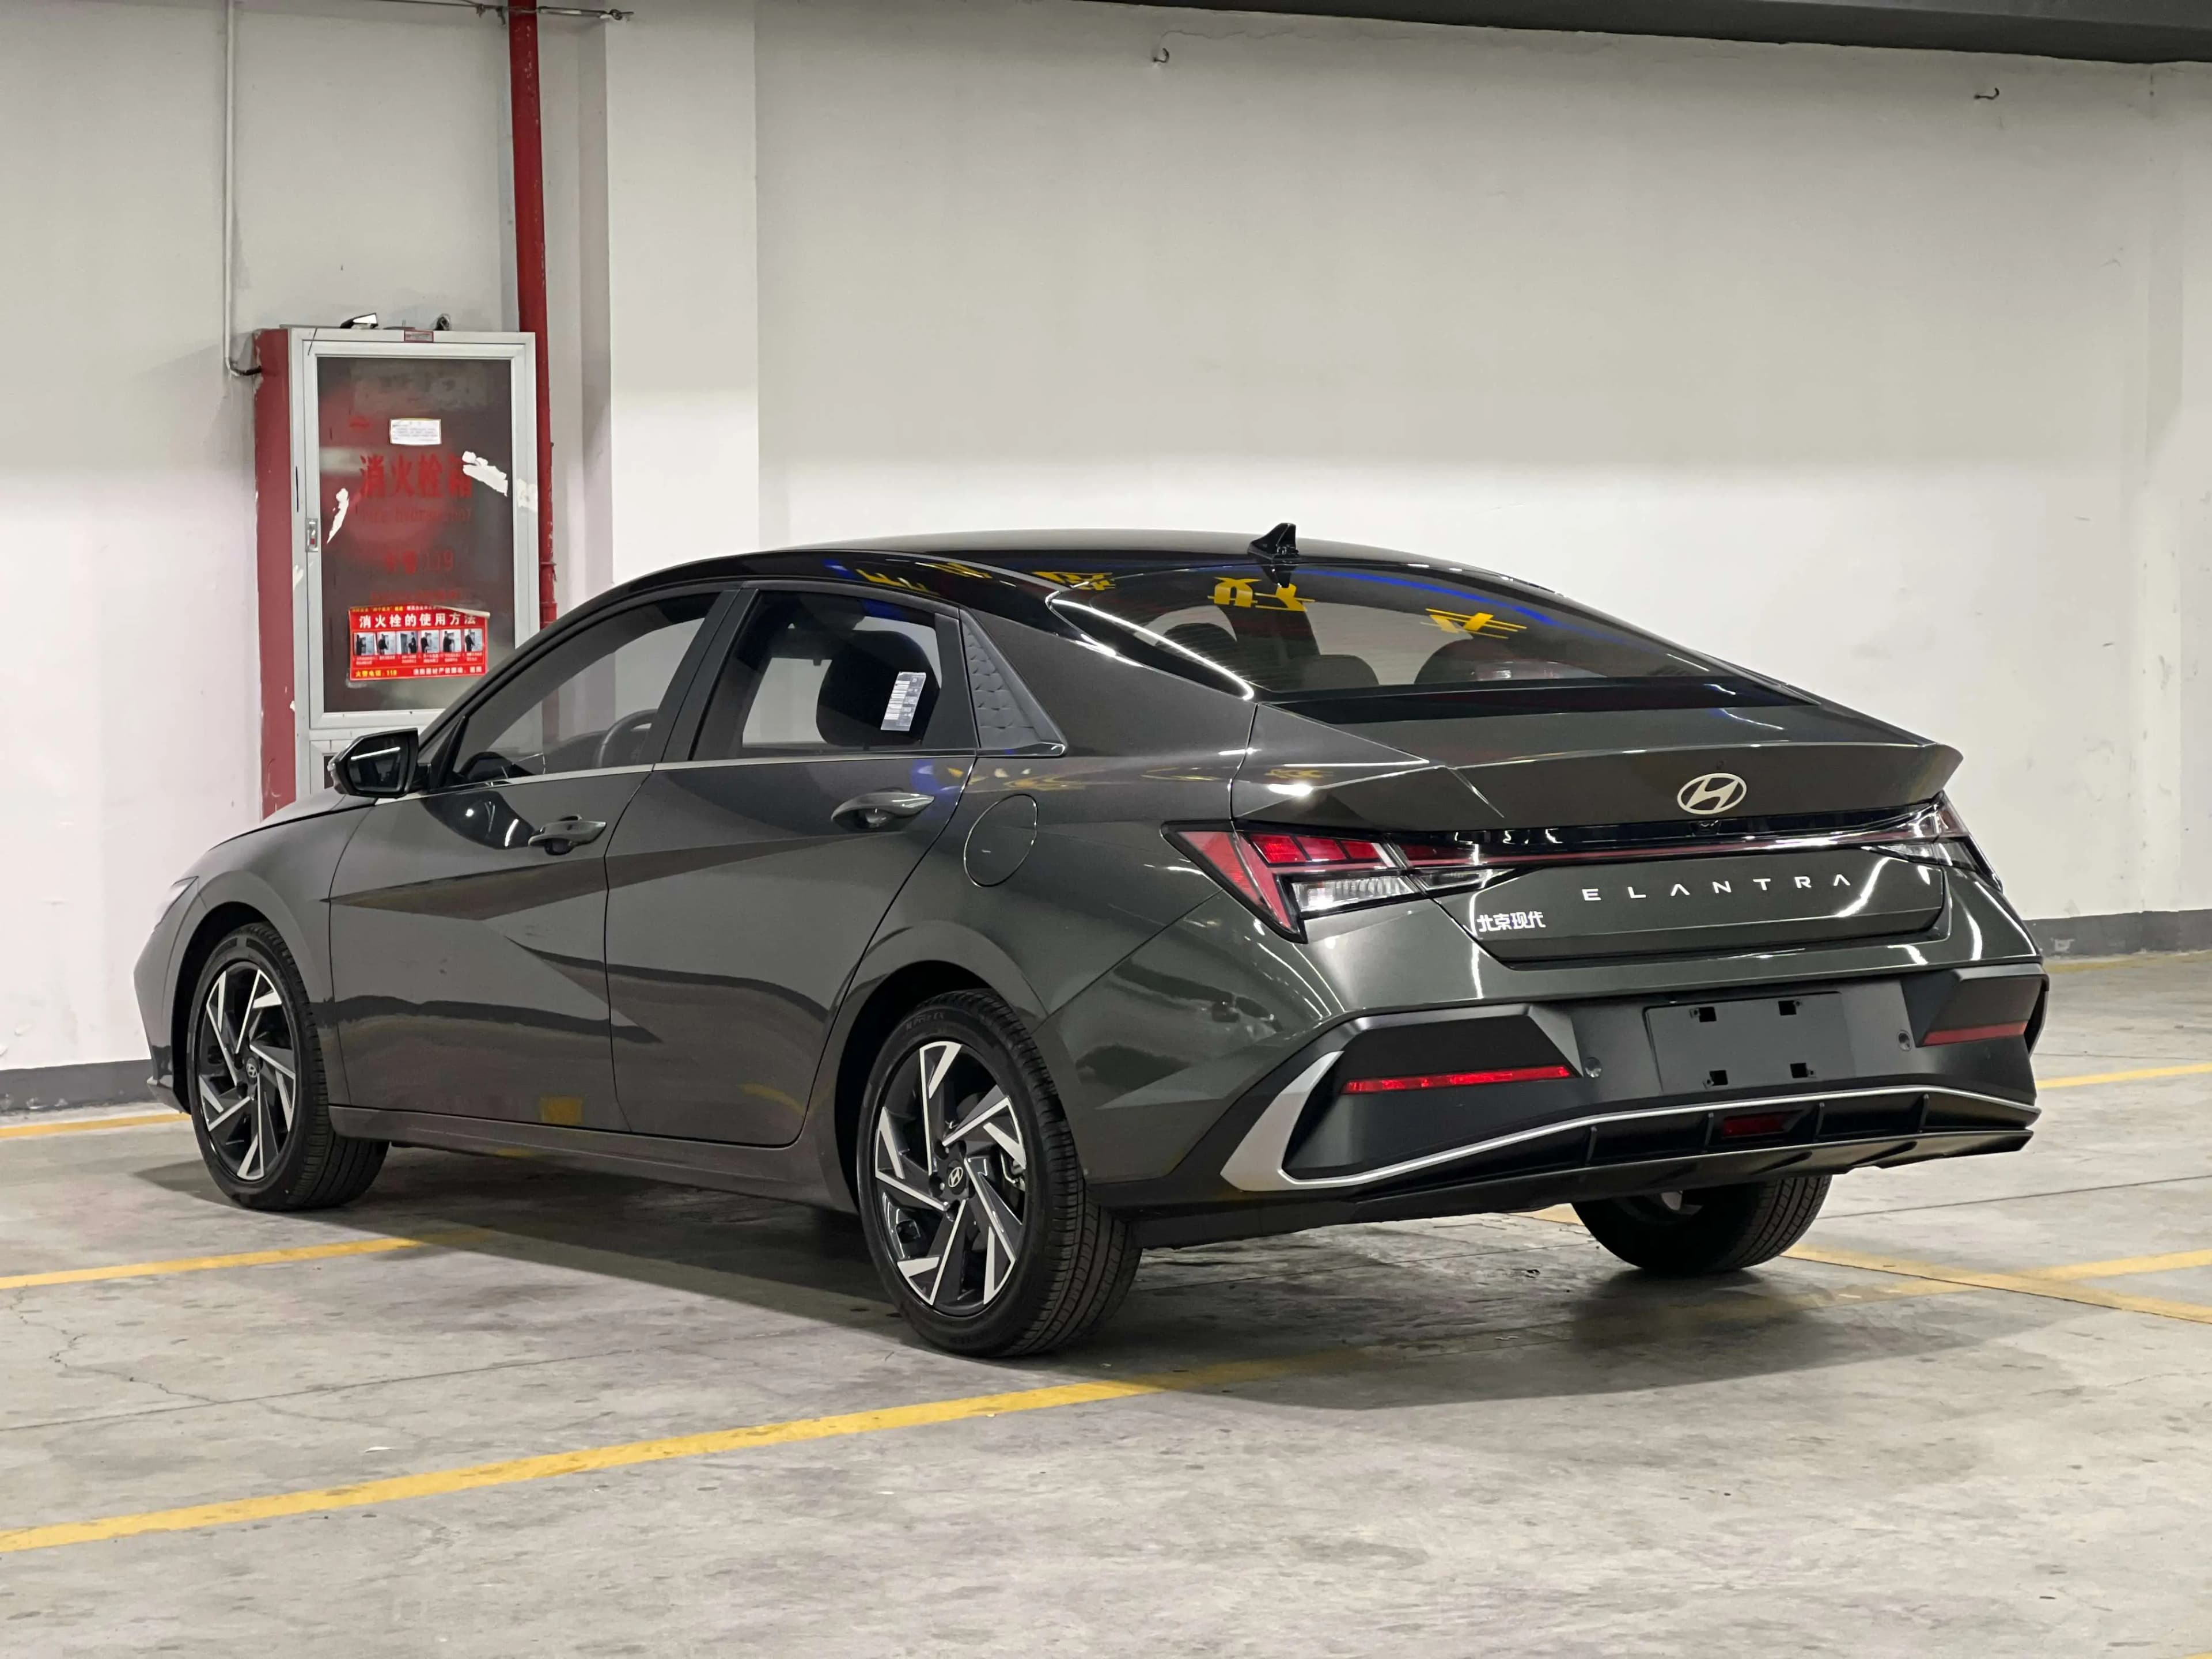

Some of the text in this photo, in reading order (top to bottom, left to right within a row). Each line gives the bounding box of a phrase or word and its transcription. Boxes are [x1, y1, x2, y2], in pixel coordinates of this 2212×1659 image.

[359, 613, 476, 628] 消火栓的使用方法
[1582, 874, 1850, 901] ELANTRA
[1476, 911, 1546, 932] 北京现代
